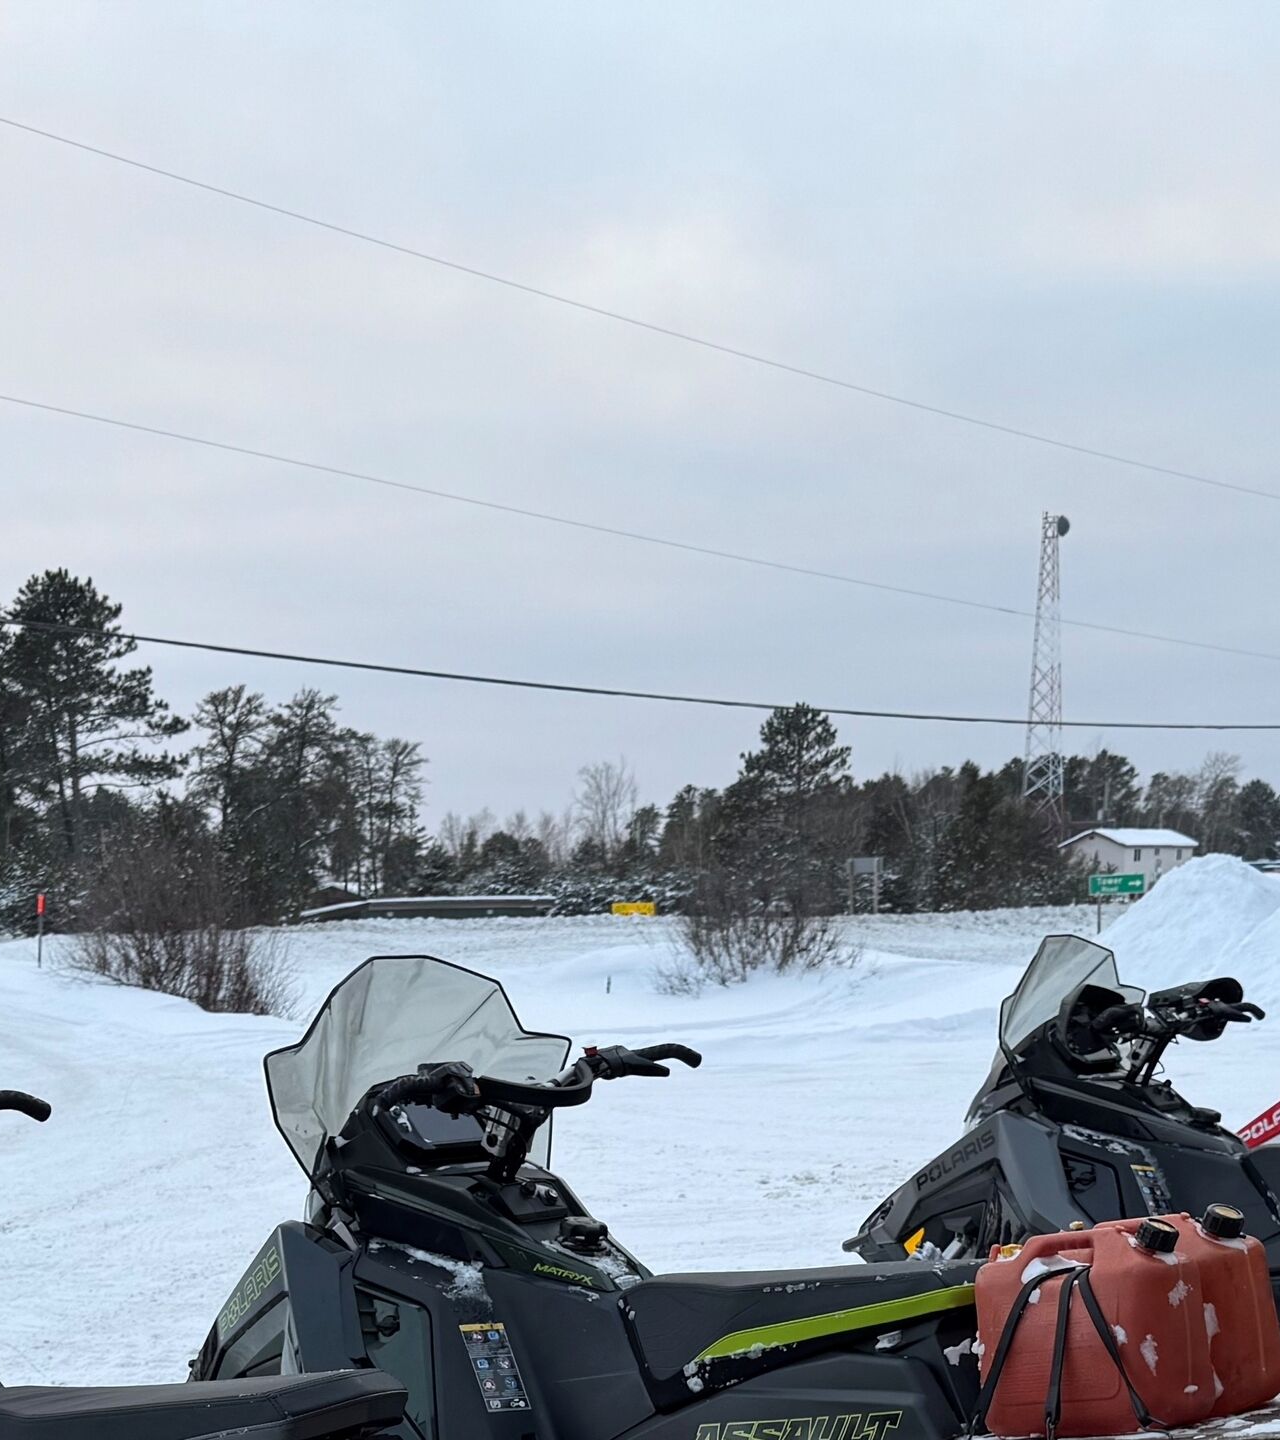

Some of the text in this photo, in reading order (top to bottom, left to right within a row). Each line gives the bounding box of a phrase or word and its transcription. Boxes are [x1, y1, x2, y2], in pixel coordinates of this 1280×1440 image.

[916, 1128, 996, 1191] POLARIS
[217, 1245, 283, 1334] POLARIS
[532, 1262, 593, 1287] MATRYX
